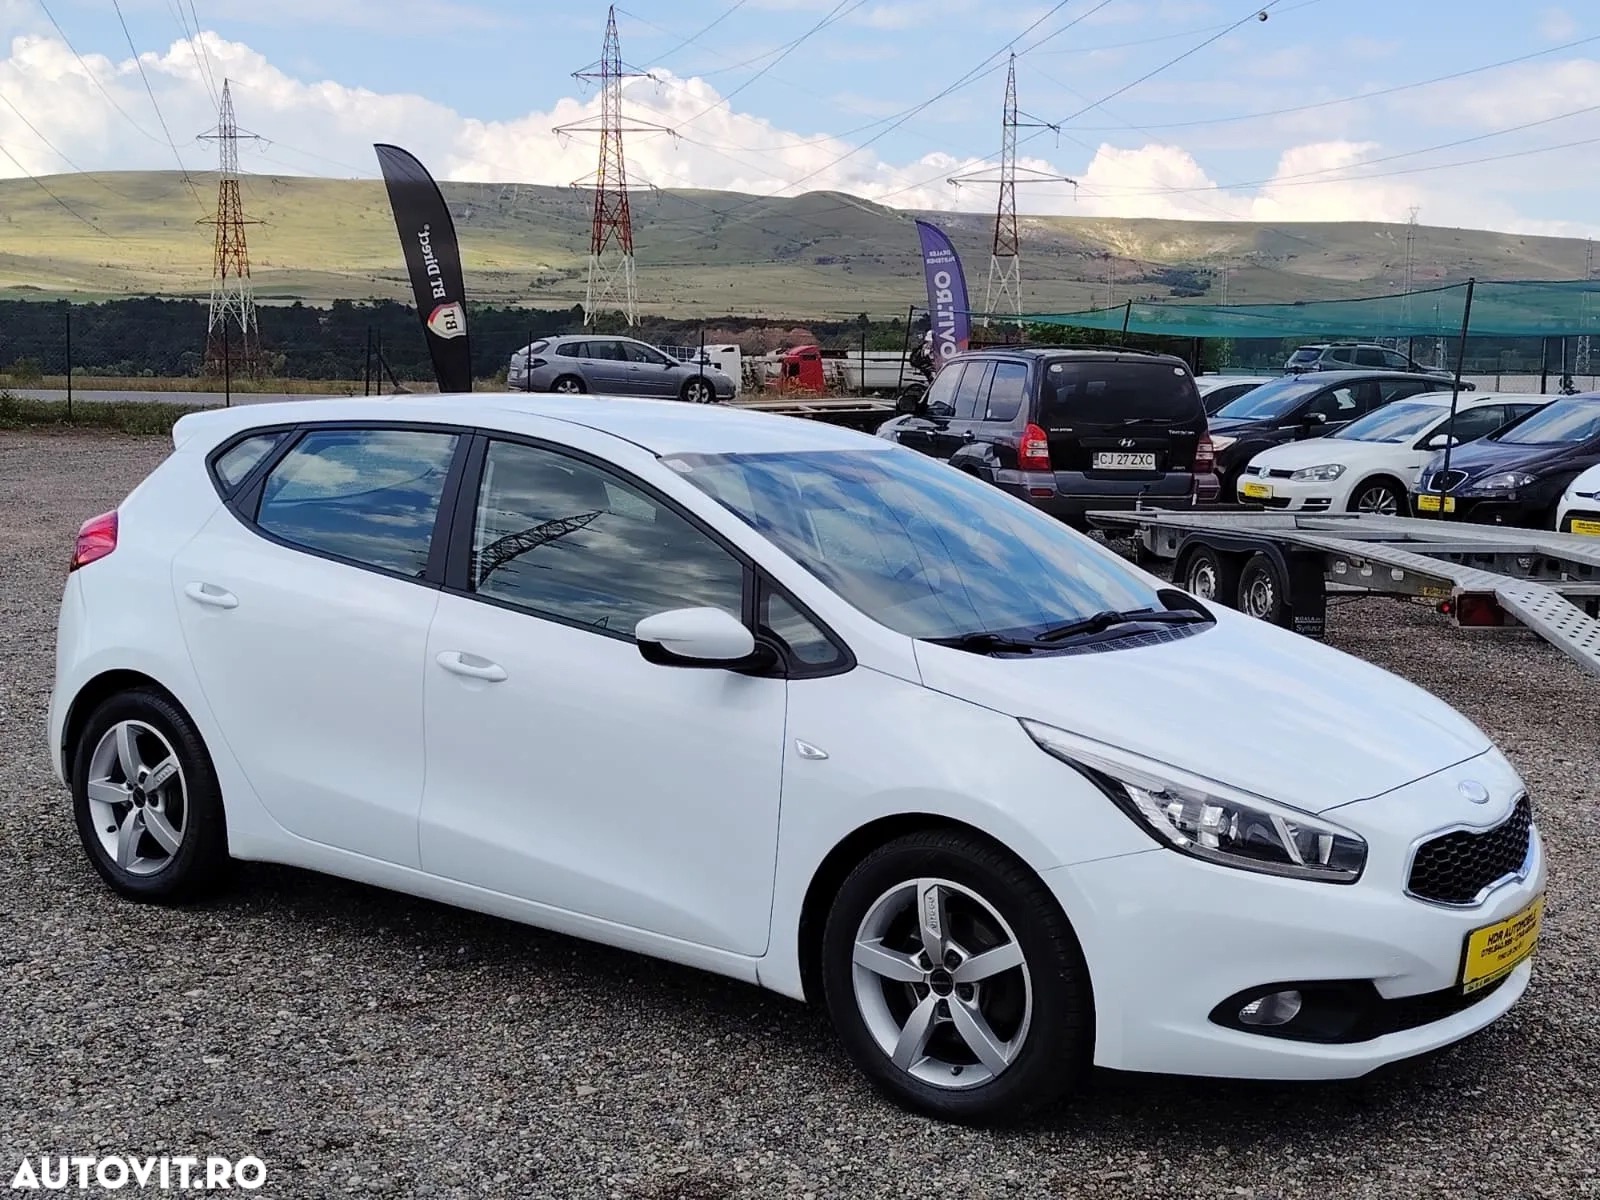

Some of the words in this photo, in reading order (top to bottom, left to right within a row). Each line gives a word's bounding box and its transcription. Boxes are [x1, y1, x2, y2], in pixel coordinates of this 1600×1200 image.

[1099, 454, 1115, 466] CJ
[1116, 454, 1130, 466] 27
[1130, 454, 1153, 466] ZXC
